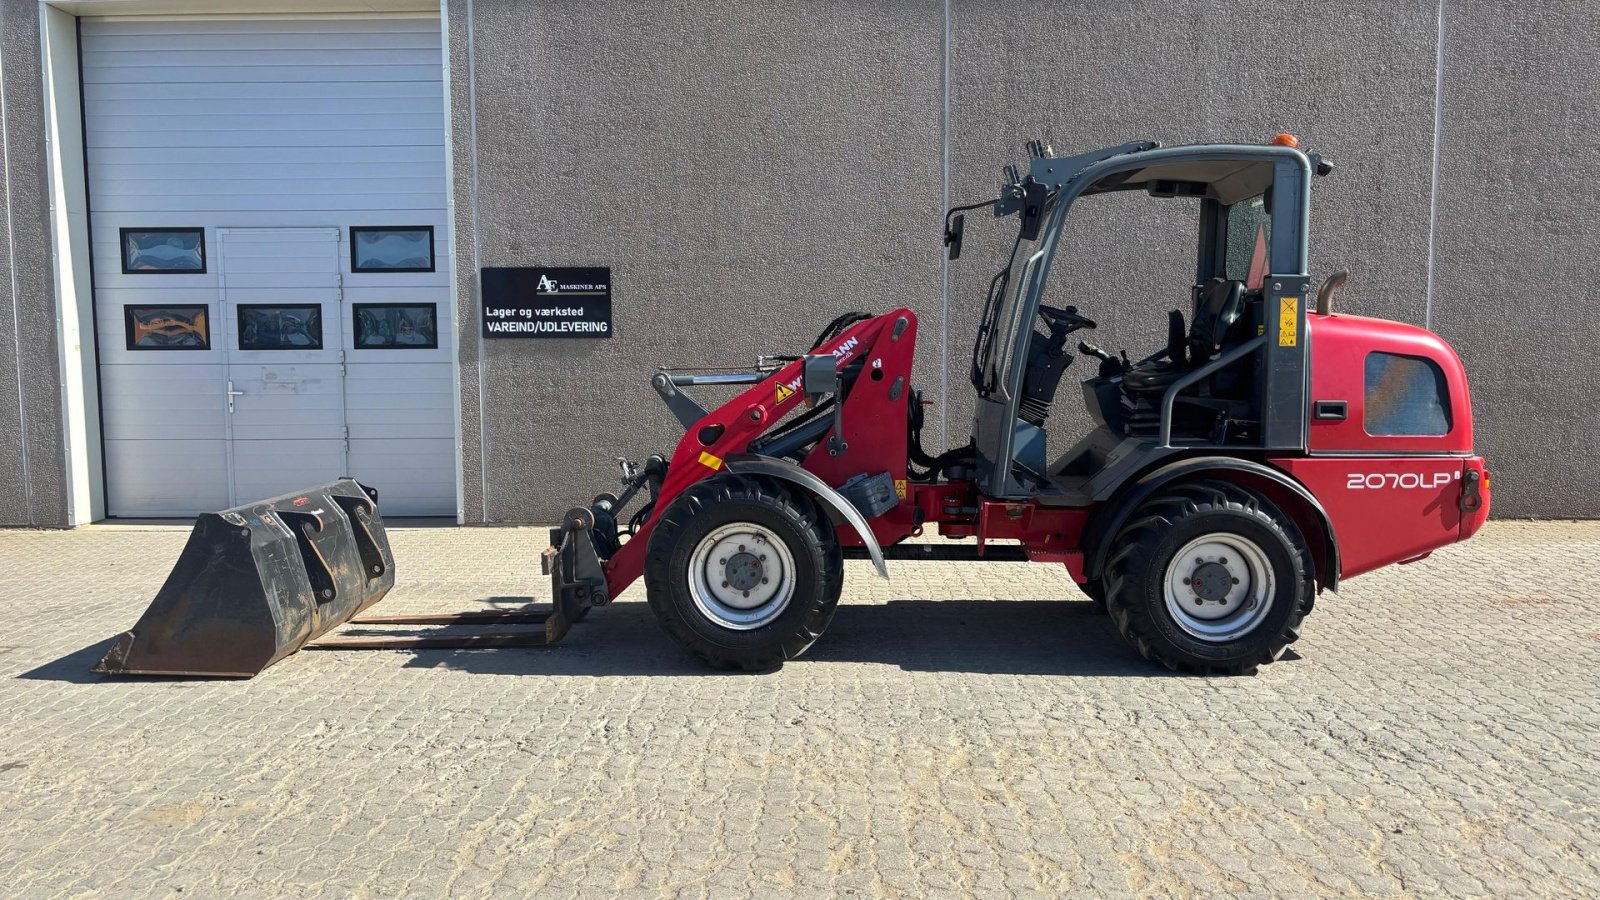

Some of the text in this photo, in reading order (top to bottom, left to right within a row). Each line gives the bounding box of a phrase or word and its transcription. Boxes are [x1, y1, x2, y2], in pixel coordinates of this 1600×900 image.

[536, 275, 559, 293] AE
[486, 306, 584, 319] Lager og værksted
[487, 321, 608, 334] VAREIND/UDLEVERING
[1346, 472, 1451, 489] 2070LP
